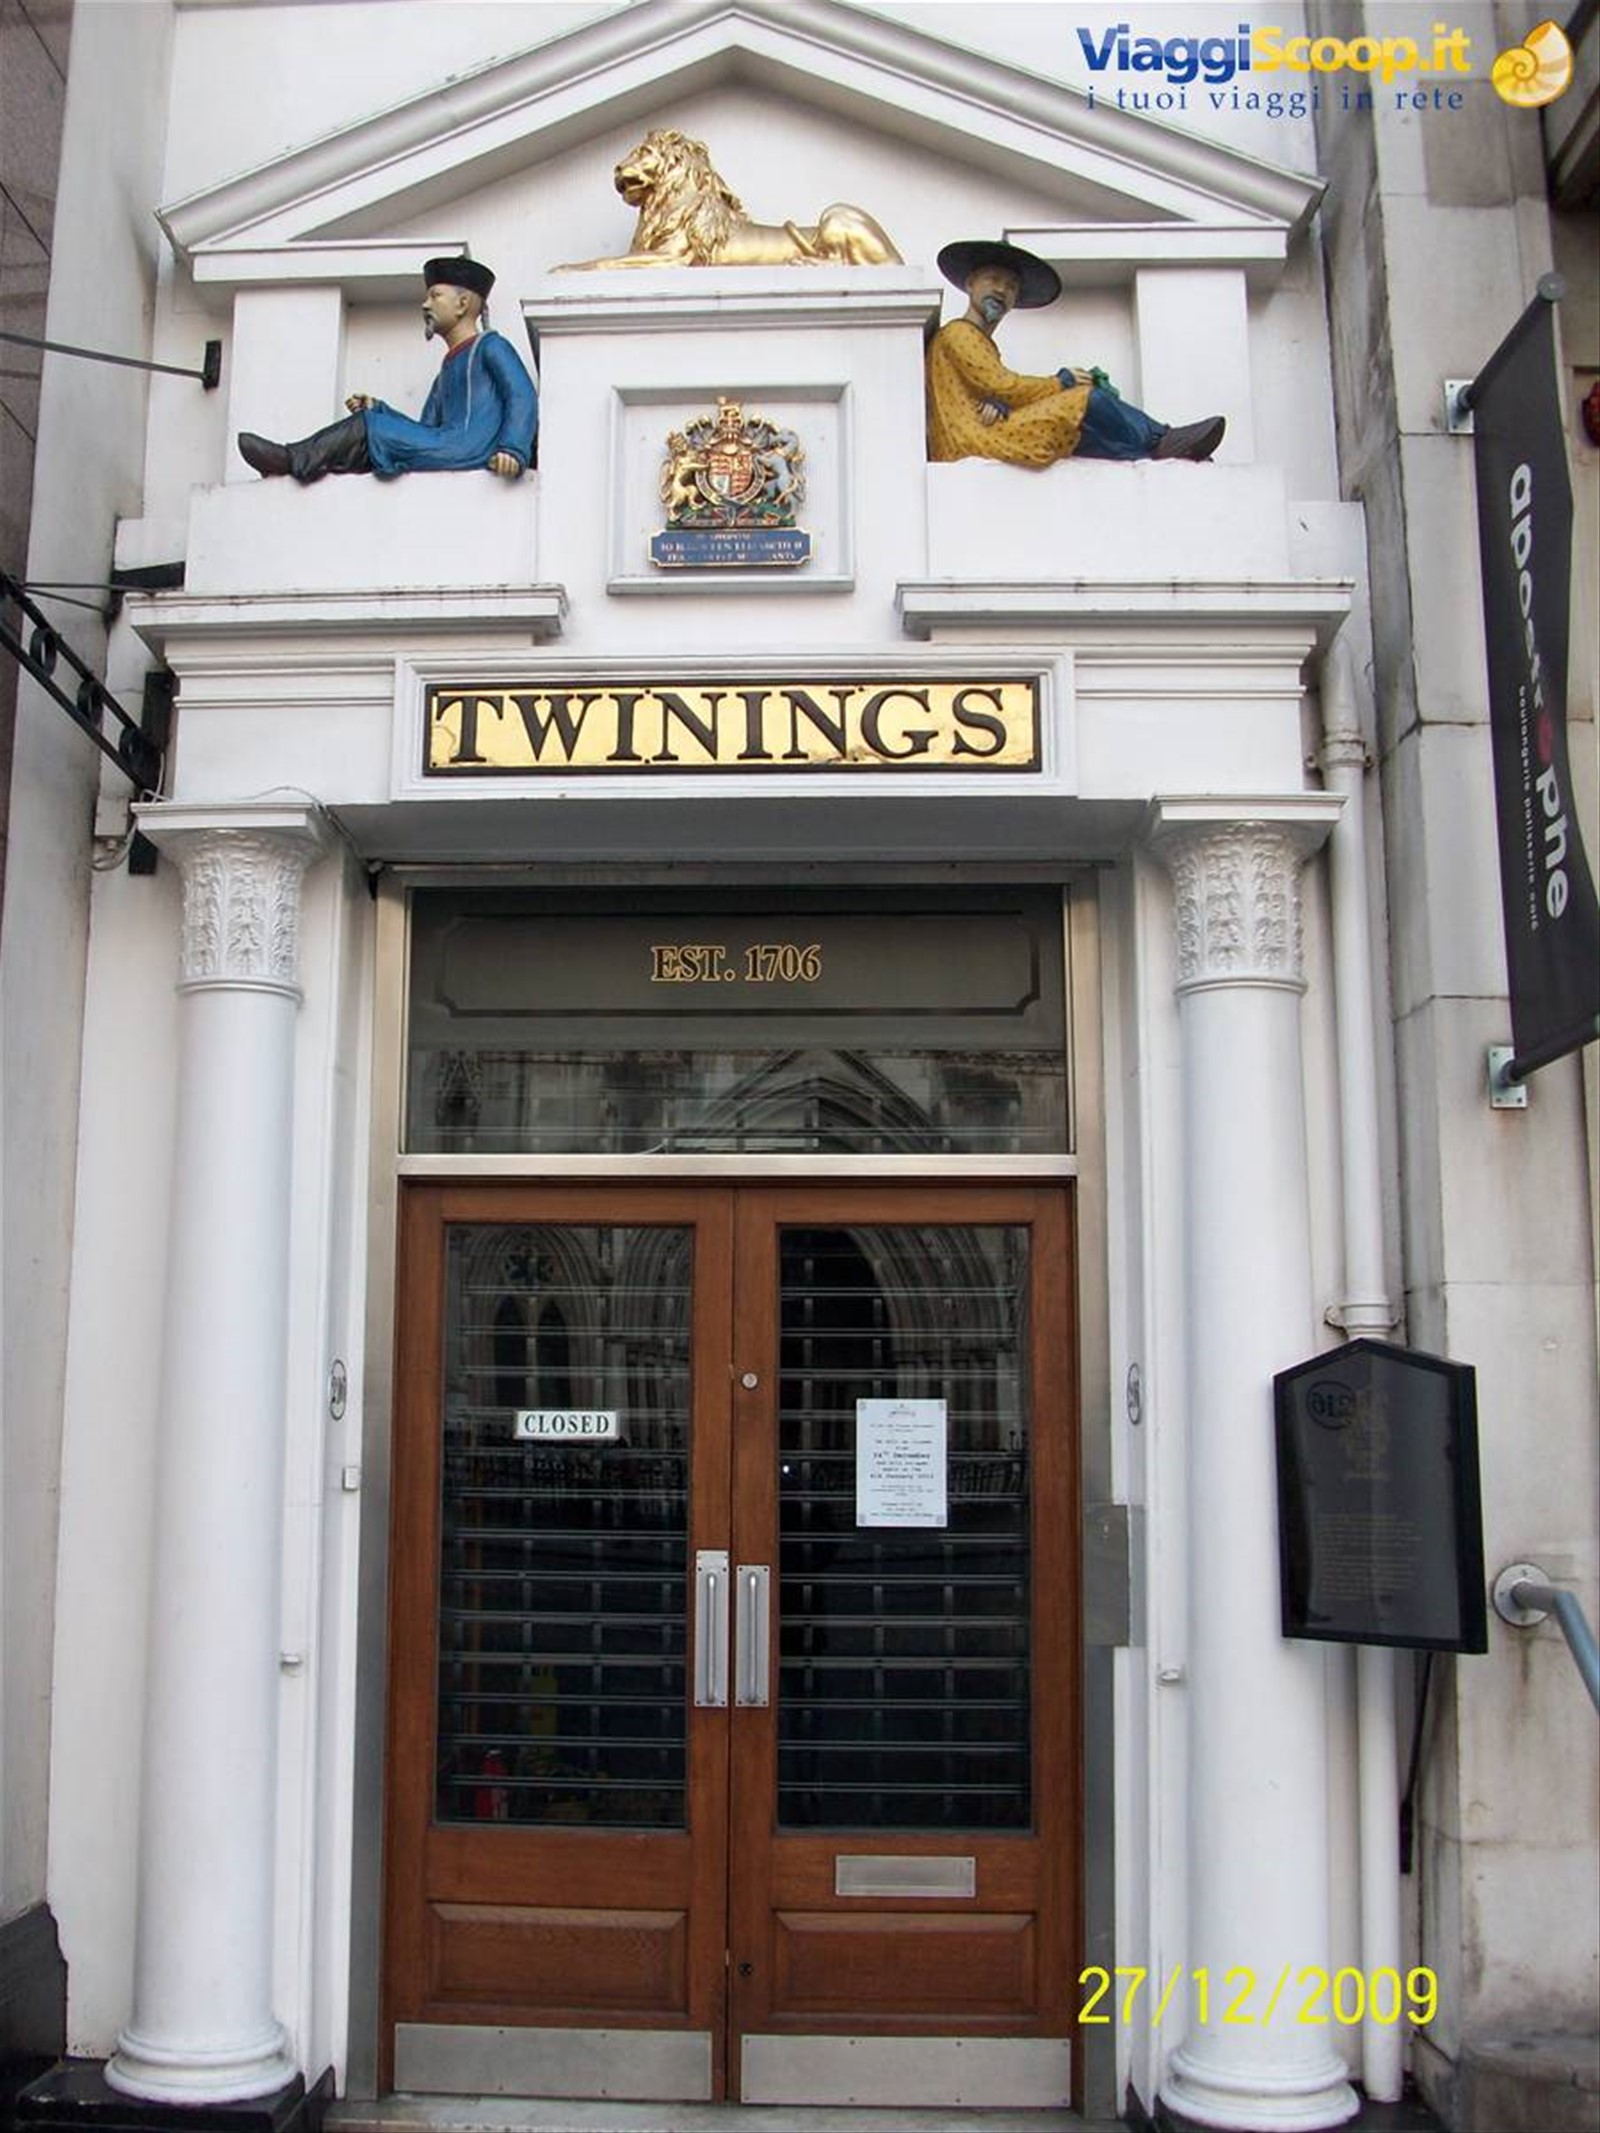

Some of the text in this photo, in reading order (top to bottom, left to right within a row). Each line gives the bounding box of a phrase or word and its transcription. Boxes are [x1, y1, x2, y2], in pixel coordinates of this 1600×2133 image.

[435, 688, 1008, 763] TWININGS
[651, 944, 822, 982] EST. 1706
[524, 1414, 610, 1434] CLOSED
